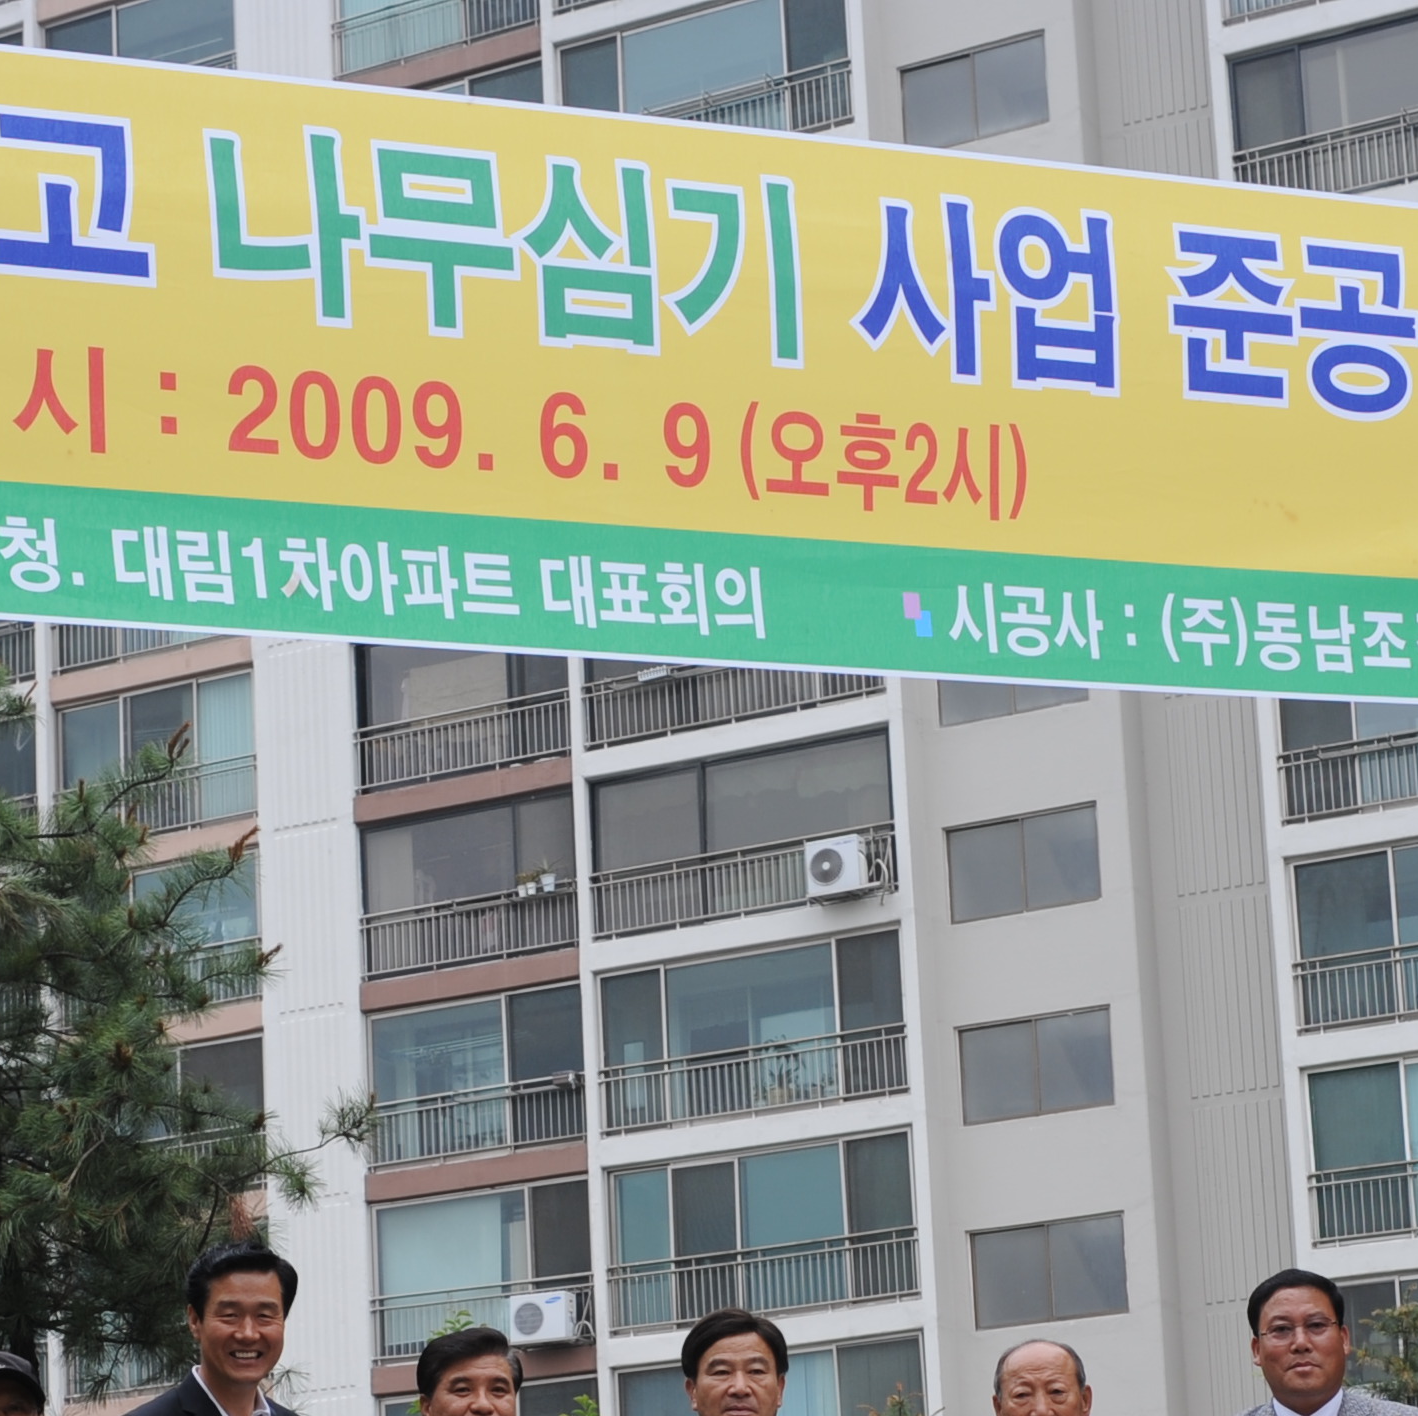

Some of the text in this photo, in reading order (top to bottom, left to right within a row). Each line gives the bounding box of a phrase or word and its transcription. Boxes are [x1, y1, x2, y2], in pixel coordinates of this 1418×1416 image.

[202, 124, 804, 369] 나무심기
[850, 192, 1120, 397] 사업
[227, 364, 494, 472] 2009.
[112, 526, 520, 617] 대림1차아파트
[540, 555, 766, 639] 대표회의
[949, 582, 1103, 660] 시공사
